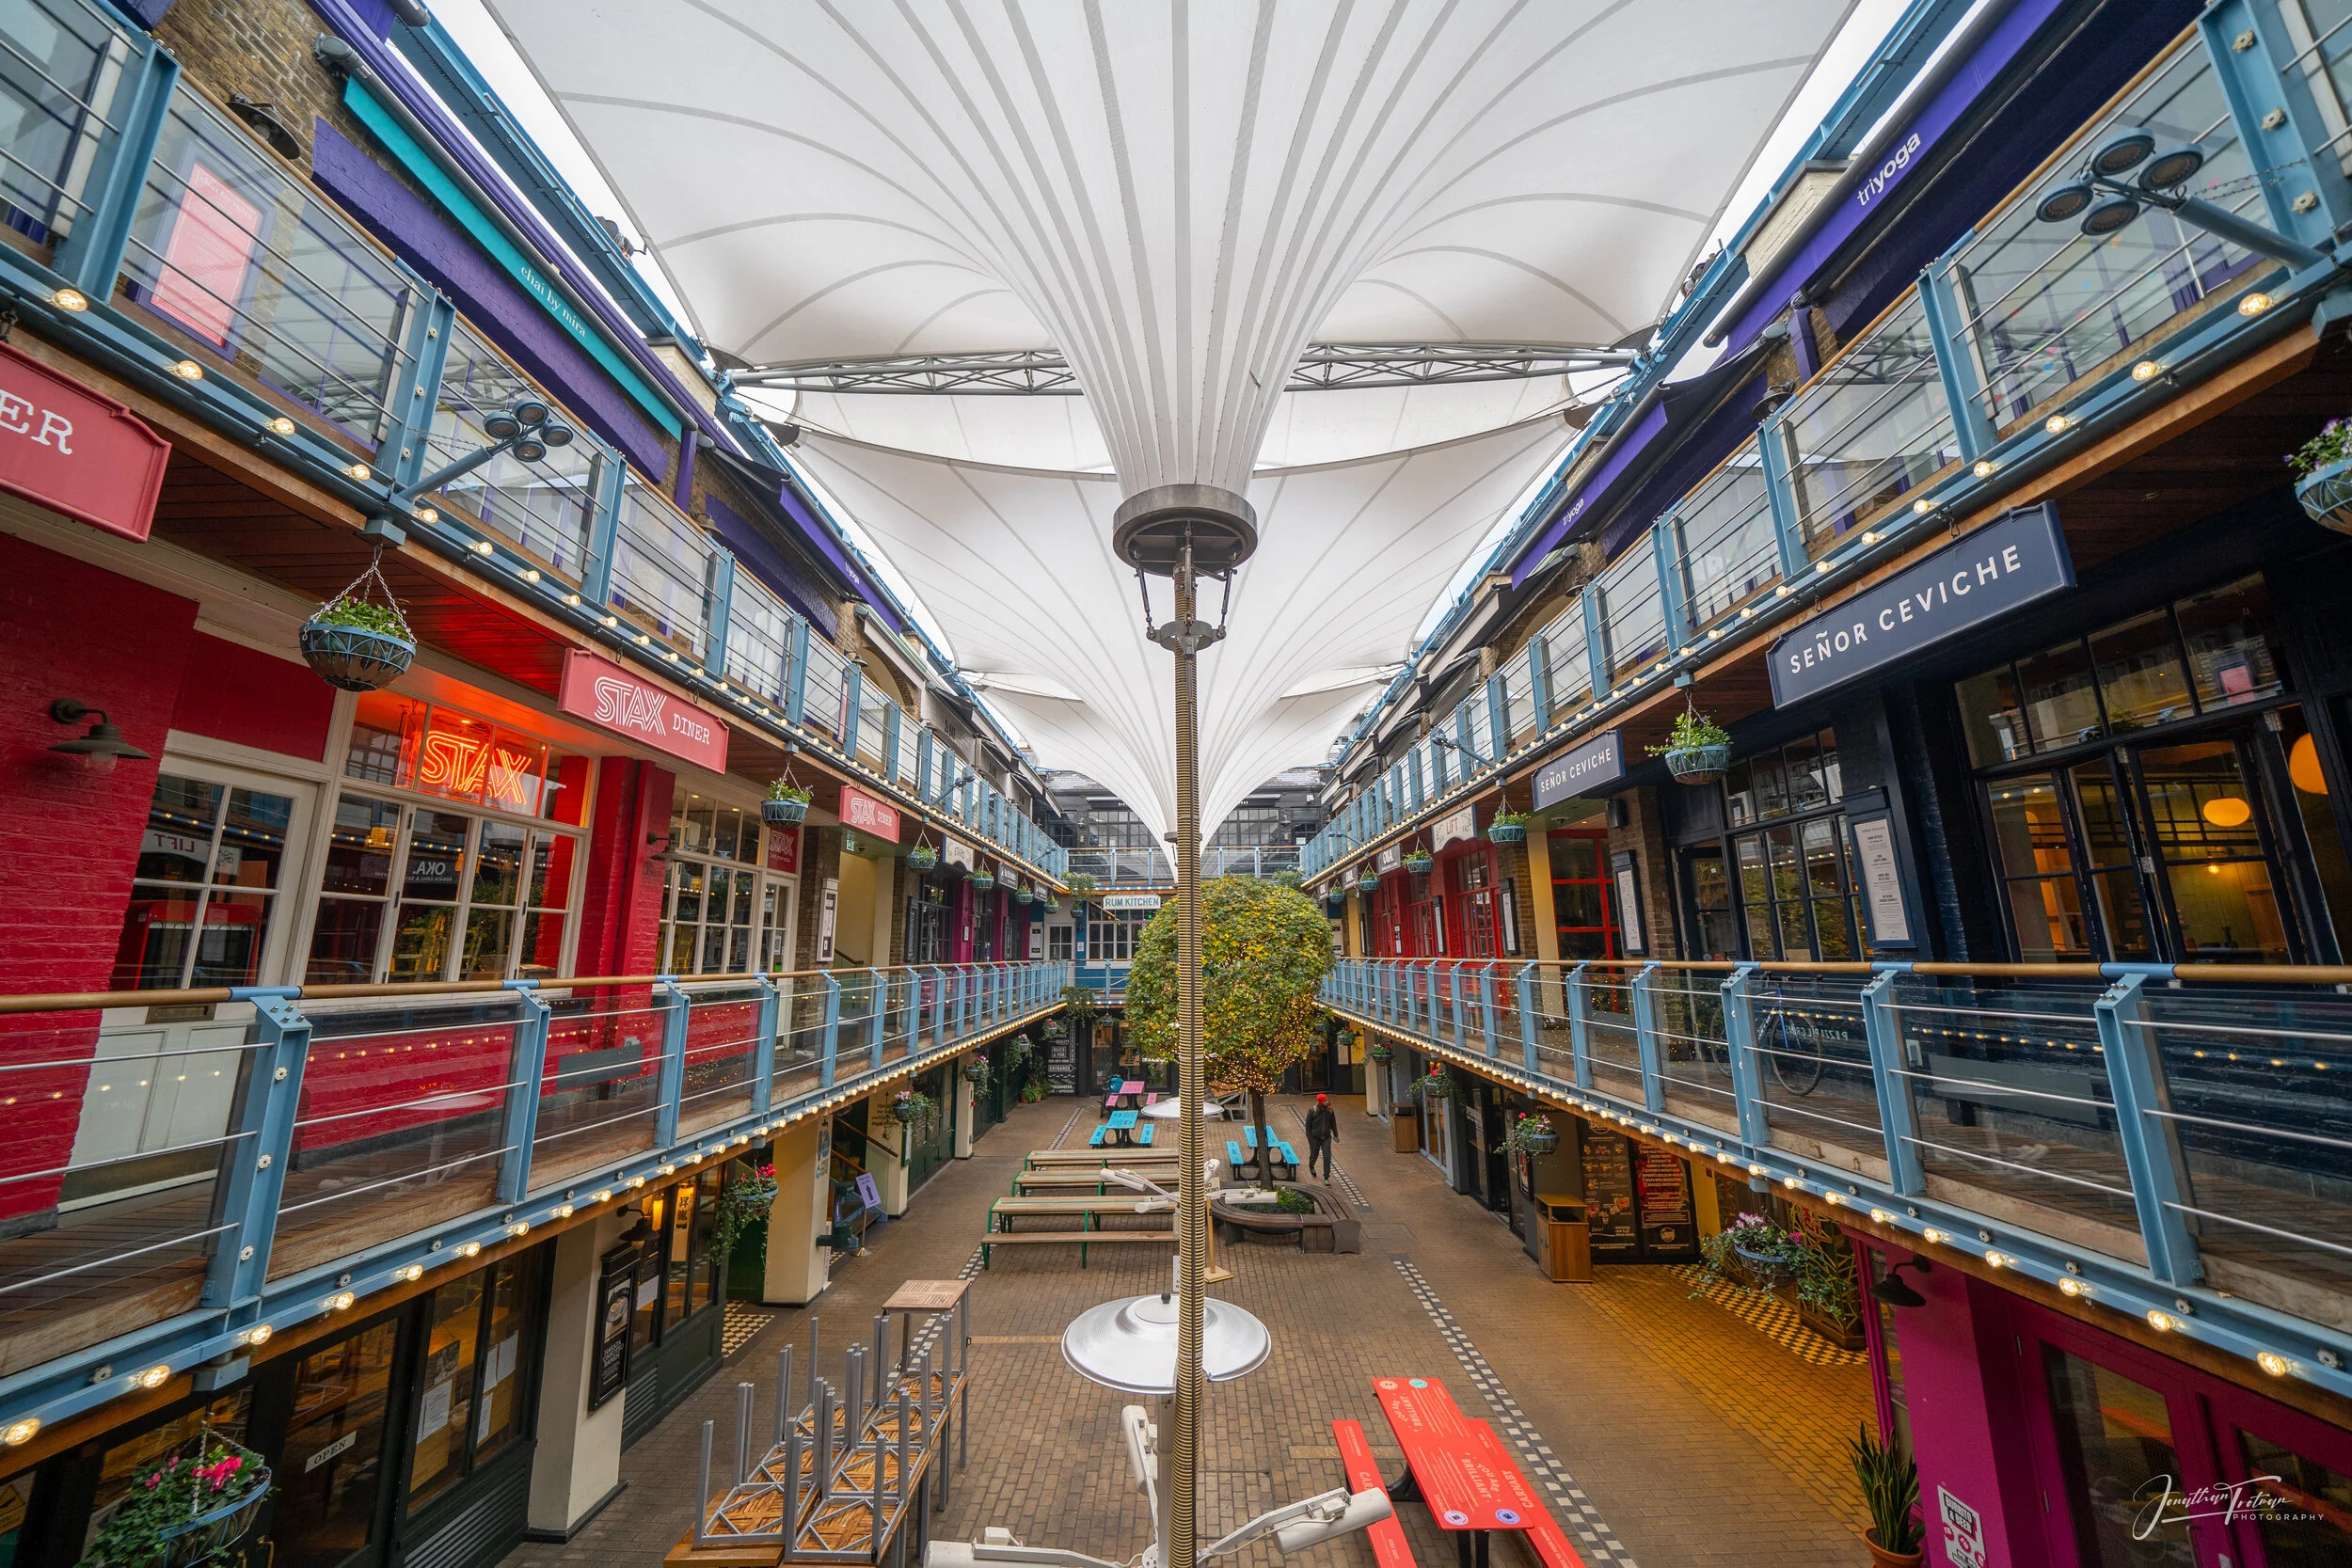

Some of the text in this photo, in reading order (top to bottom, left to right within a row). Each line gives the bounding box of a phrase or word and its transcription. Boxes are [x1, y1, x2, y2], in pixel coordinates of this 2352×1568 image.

[1857, 133, 1921, 206] triyoga
[521, 266, 586, 338] chai by mira
[1563, 499, 1584, 526] triyoga
[1790, 545, 2022, 674] SEÑOR CEVICHE
[594, 675, 710, 745] STAX DINER
[421, 731, 532, 805] STAX
[1540, 748, 1612, 793] SEÑOR CEVICHE
[850, 797, 893, 827] STAX DINER
[1446, 817, 1458, 835] LIFT
[769, 830, 795, 857] STAX
[1104, 897, 1159, 907] RUM KITCHEN
[1401, 1395, 1423, 1428] BRILLIANT
[313, 1439, 347, 1465] OPEN
[1460, 1457, 1492, 1499] BRILLIANT
[1477, 1463, 1500, 1493] YOU ARE
[1502, 1470, 1534, 1509] CARNABY
[1946, 1496, 1972, 1522] BURRITO
[1955, 1514, 1972, 1534] BEER
